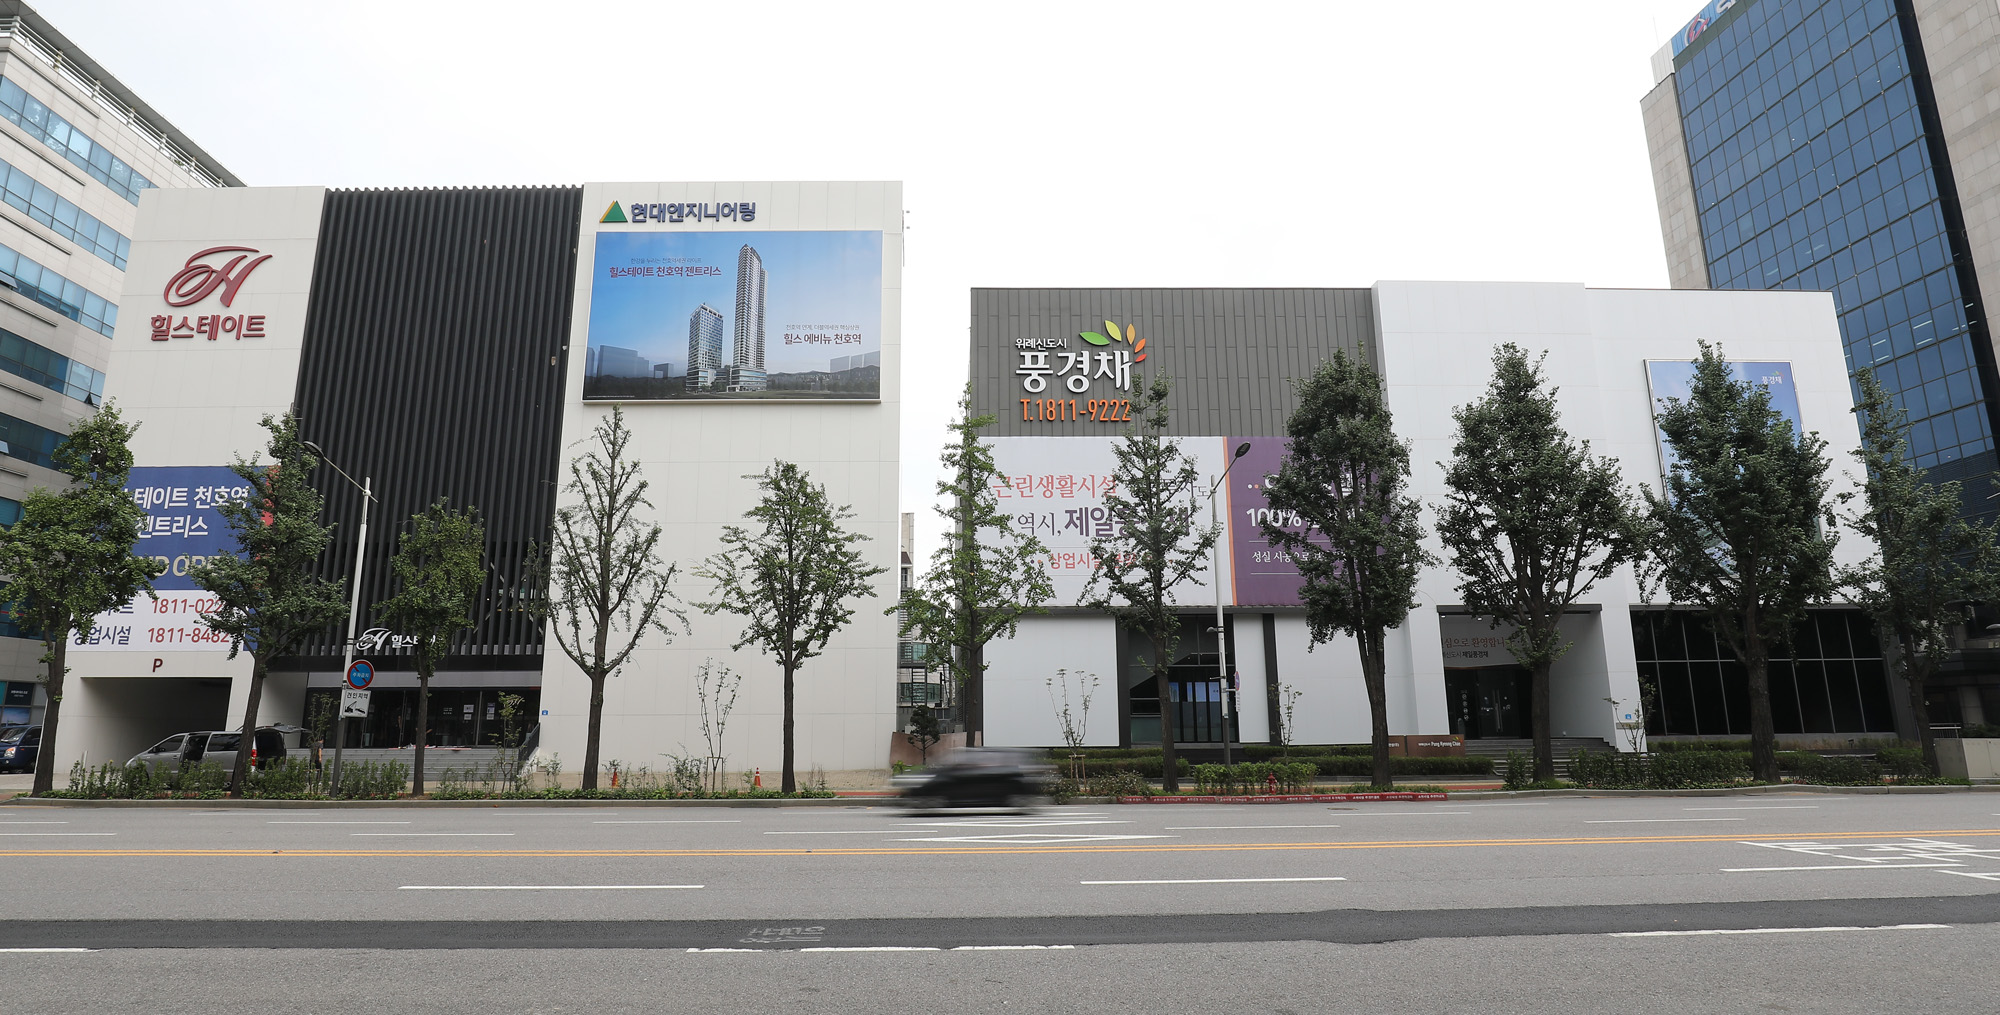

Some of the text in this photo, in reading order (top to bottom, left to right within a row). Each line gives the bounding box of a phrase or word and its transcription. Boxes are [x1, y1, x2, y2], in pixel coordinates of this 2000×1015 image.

[630, 201, 757, 223] 현대엔지니어링
[609, 265, 722, 278] 힐스테이트 천호역 젠트리스
[150, 314, 266, 342] 힐스테이트
[784, 333, 861, 344] 힐스 에비뉴 천호역
[1015, 338, 1067, 350] 위례신도시
[1015, 351, 1132, 393] 풍경채
[1761, 375, 1782, 384] 풍경채
[1020, 398, 1132, 422] T.1811-9222
[122, 486, 189, 510] 테이트
[1017, 511, 1062, 537] 역시,
[1251, 551, 1271, 563] 성실
[147, 627, 230, 643] 1811-8482
[1442, 637, 1470, 649] 심으로
[152, 658, 163, 673] P
